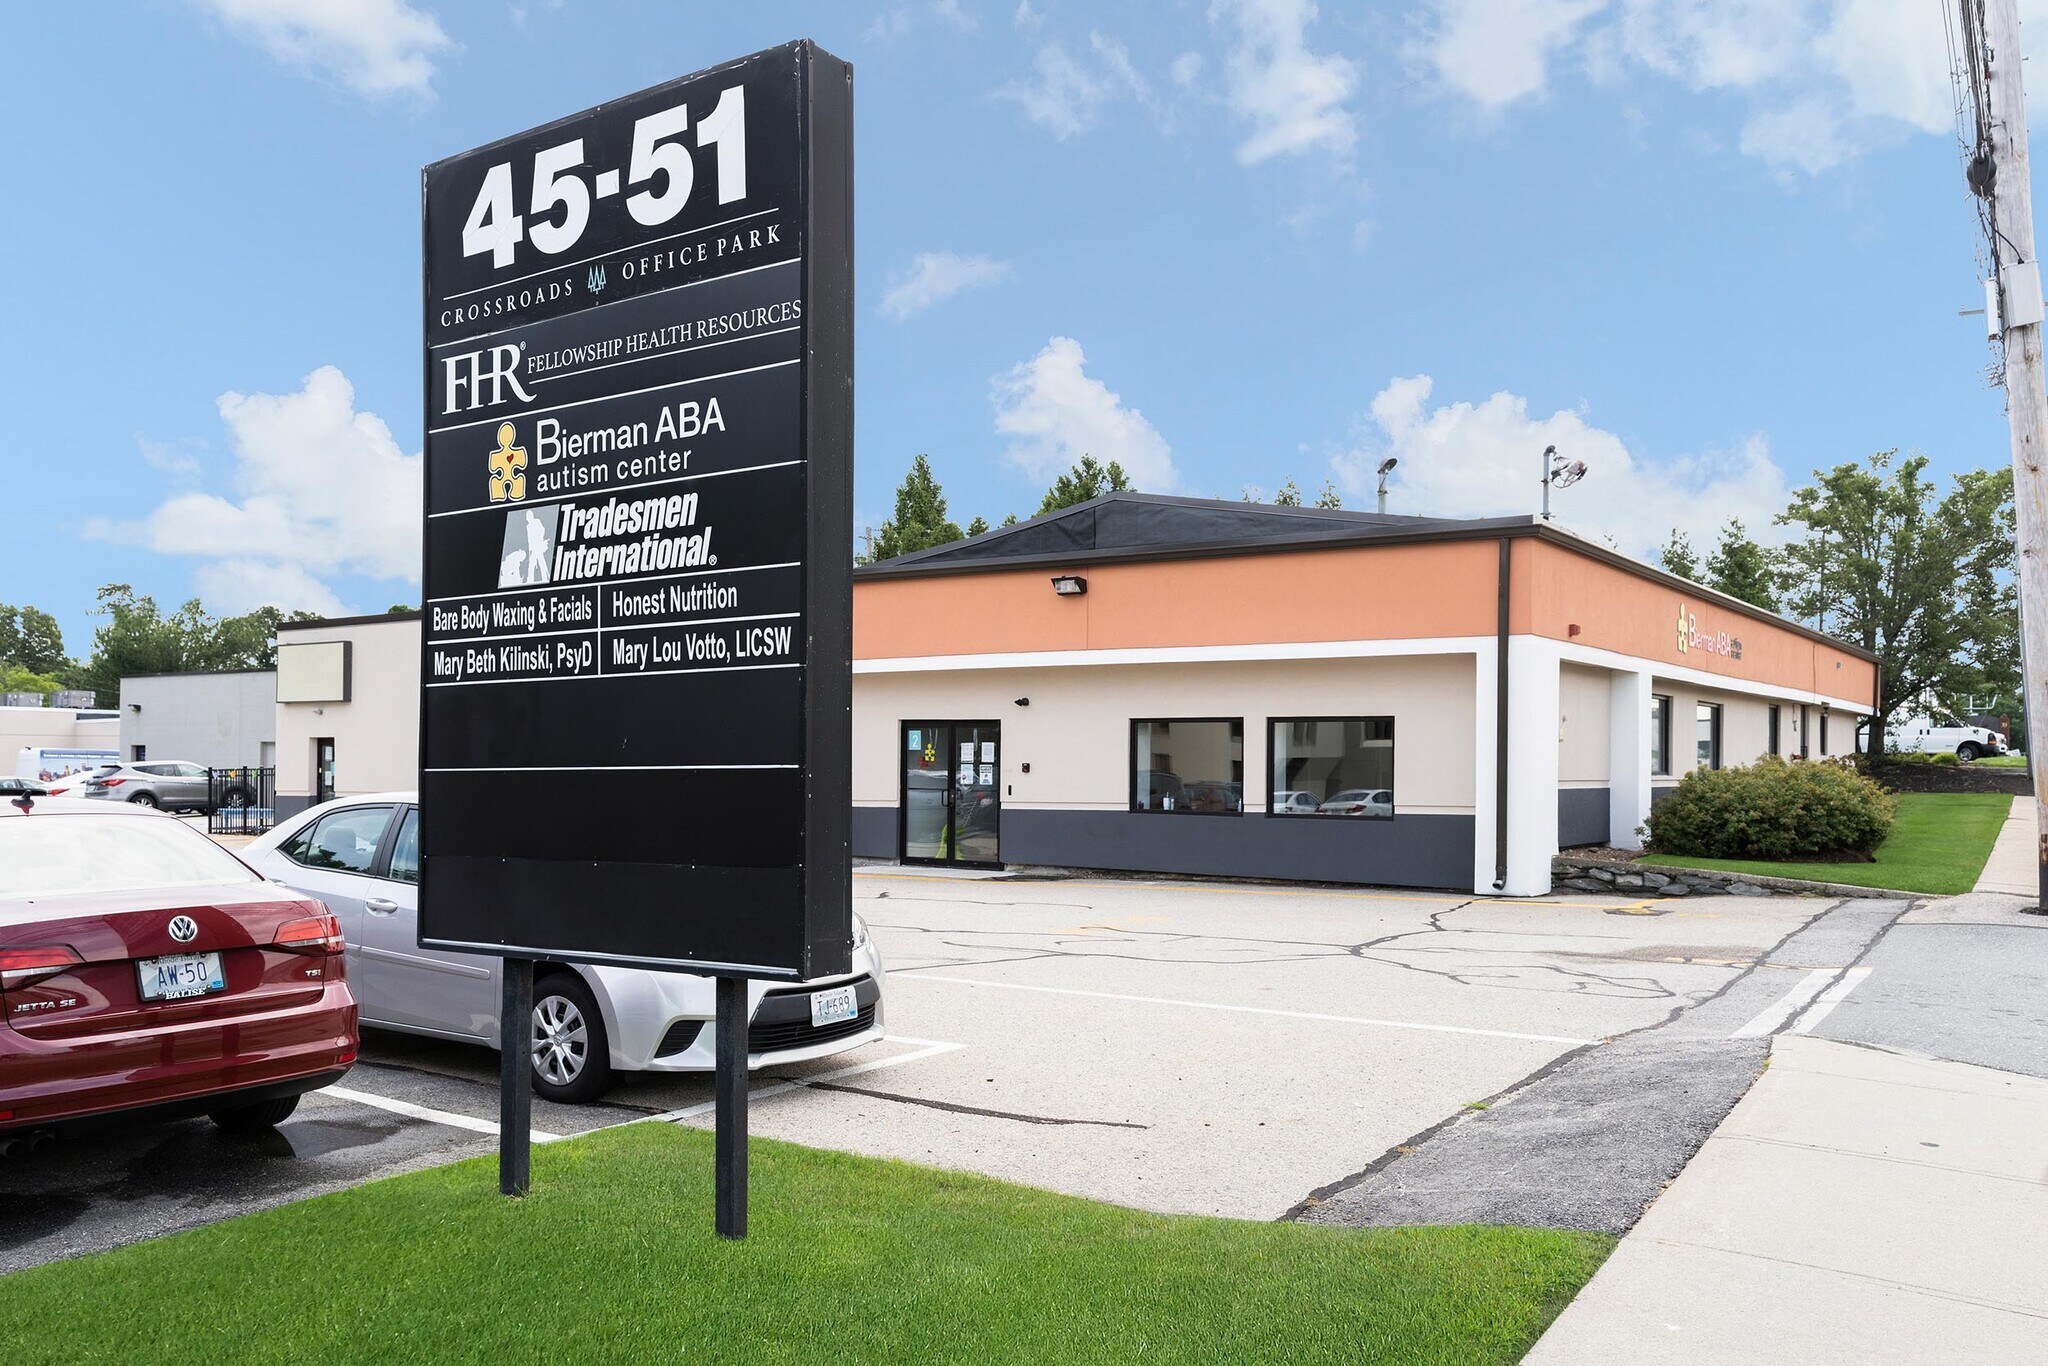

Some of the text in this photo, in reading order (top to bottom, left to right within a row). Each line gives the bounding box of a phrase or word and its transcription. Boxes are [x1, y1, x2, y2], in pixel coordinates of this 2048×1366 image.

[462, 84, 747, 269] 45-51
[440, 224, 781, 327] CROSSROADS OFFICE PARK
[527, 300, 801, 374] FELLOWSHIP HEALTH RESOURCES
[536, 397, 726, 466] Bierman ABA
[537, 448, 692, 492] autism center
[560, 492, 699, 543] Tradesmen
[433, 595, 592, 634] Bare Body Waxing & Facials
[612, 585, 738, 617] Honest Nutrition
[434, 640, 593, 681] Mary Beth Kilinski, PsyD
[612, 626, 792, 670] Mary Lou Votto, LICSW
[1716, 629, 1730, 658] ABA
[912, 734, 919, 748] 2
[157, 961, 208, 988] AW-50
[13, 998, 77, 1012] JETTA SE
